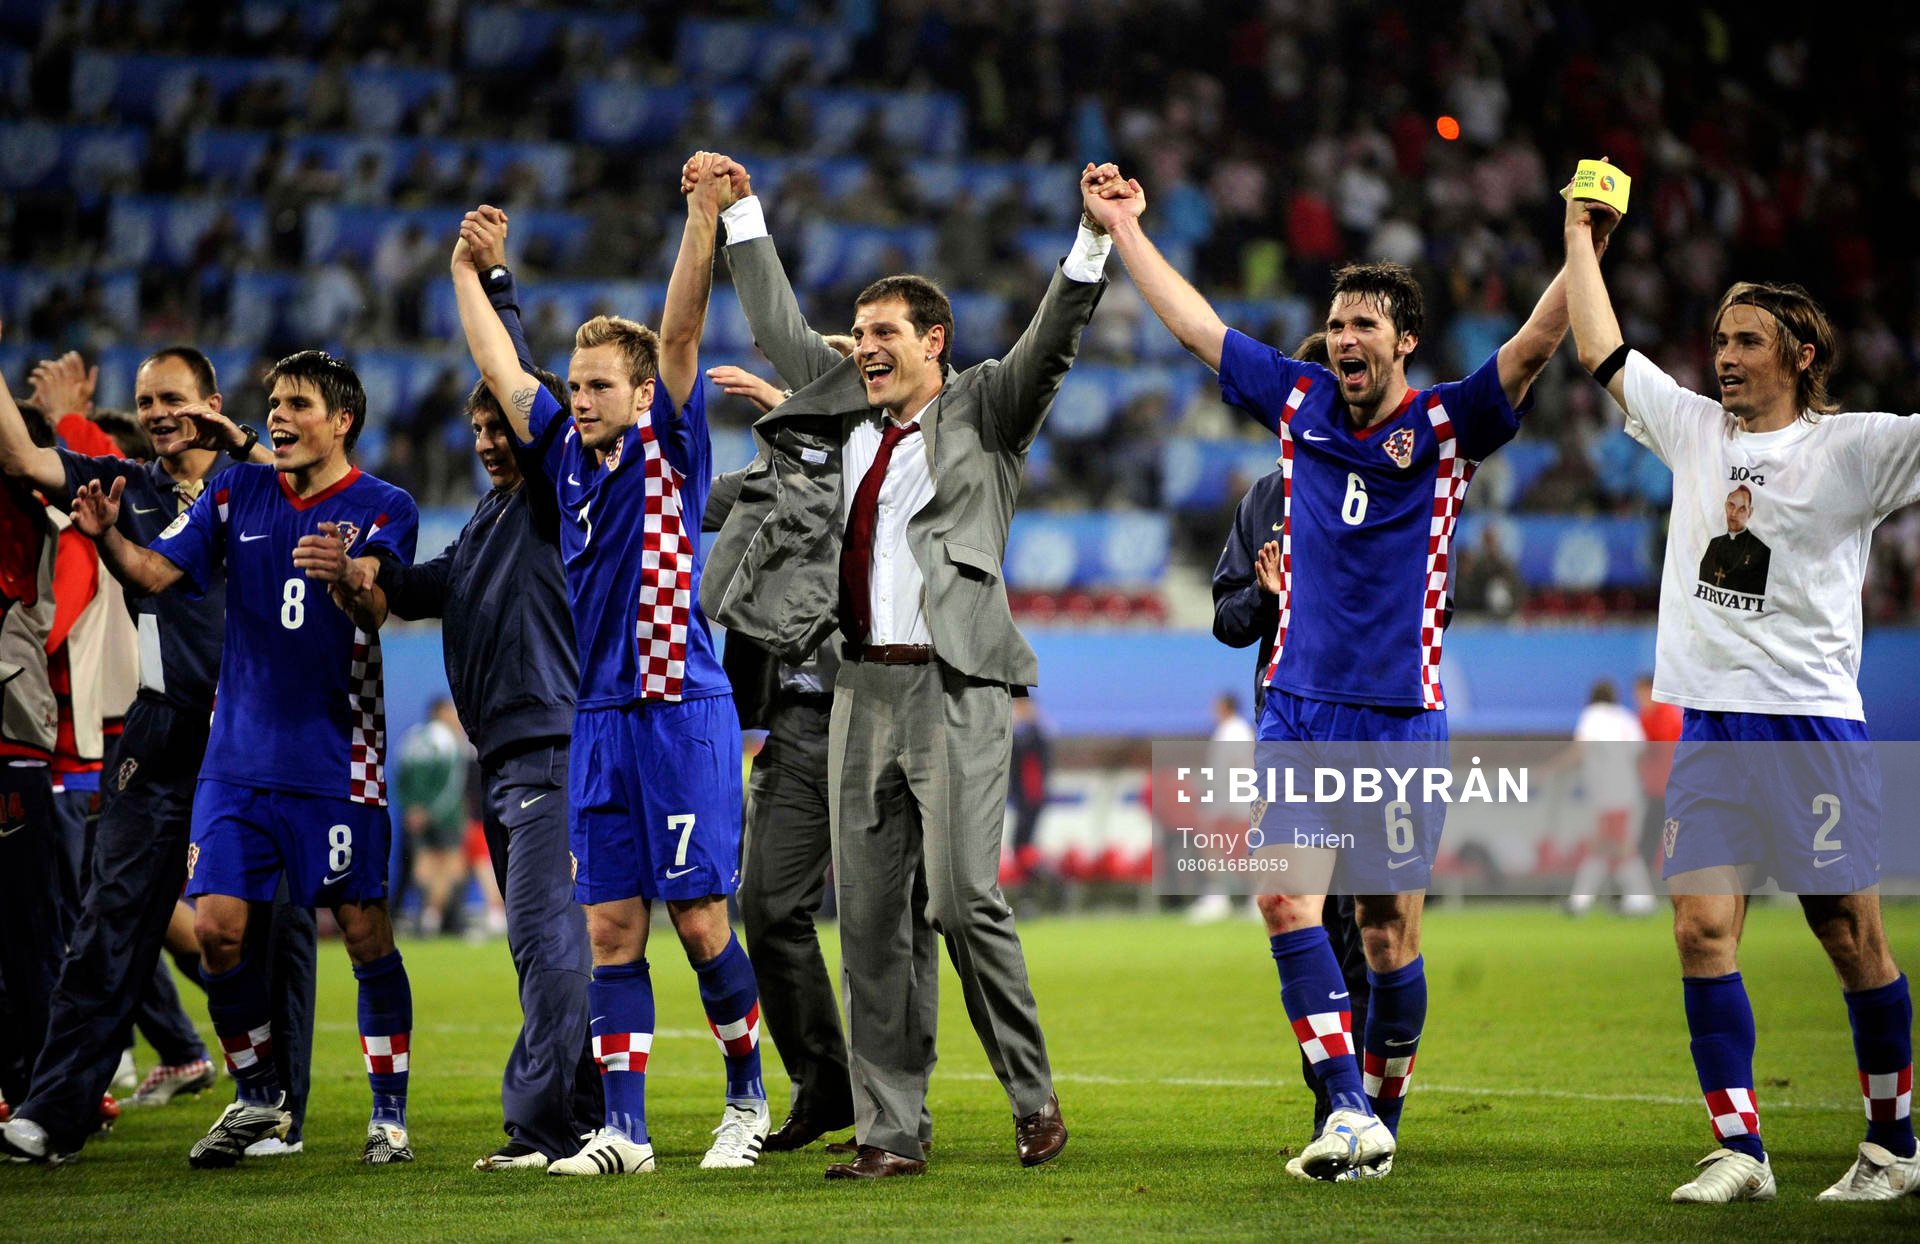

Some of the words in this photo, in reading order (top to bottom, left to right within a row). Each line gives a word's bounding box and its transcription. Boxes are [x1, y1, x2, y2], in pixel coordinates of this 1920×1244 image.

[1341, 472, 1369, 526] 6
[1729, 466, 1766, 486] BOG
[281, 578, 306, 630] 8
[1693, 583, 1766, 613] HRVATI
[328, 824, 352, 872] 8
[667, 813, 696, 866] 7
[1384, 800, 1415, 853] 6
[1812, 793, 1842, 851] 2
